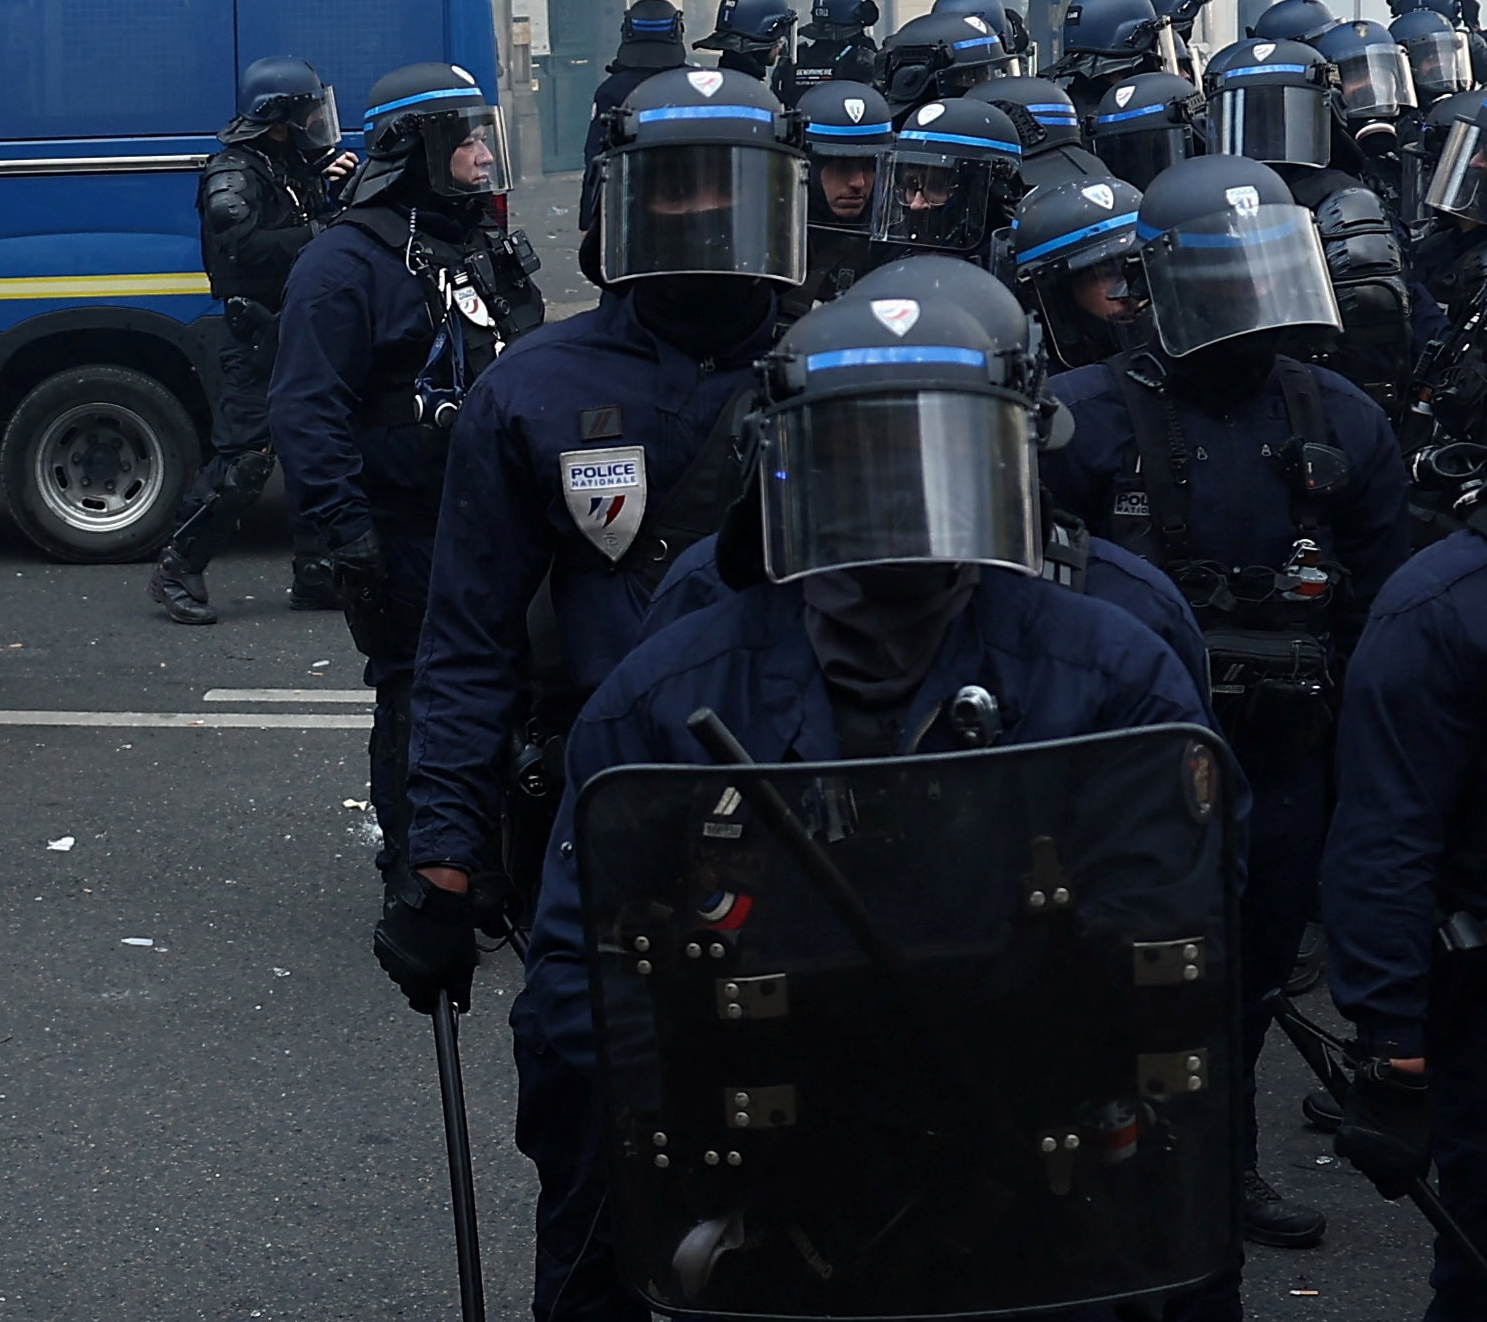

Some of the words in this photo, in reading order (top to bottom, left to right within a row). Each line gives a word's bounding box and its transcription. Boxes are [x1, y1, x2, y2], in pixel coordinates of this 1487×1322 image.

[570, 463, 636, 479] POLICE
[571, 476, 637, 488] NATIONALE
[1118, 493, 1148, 506] POL
[1117, 505, 1148, 514] NATIO
